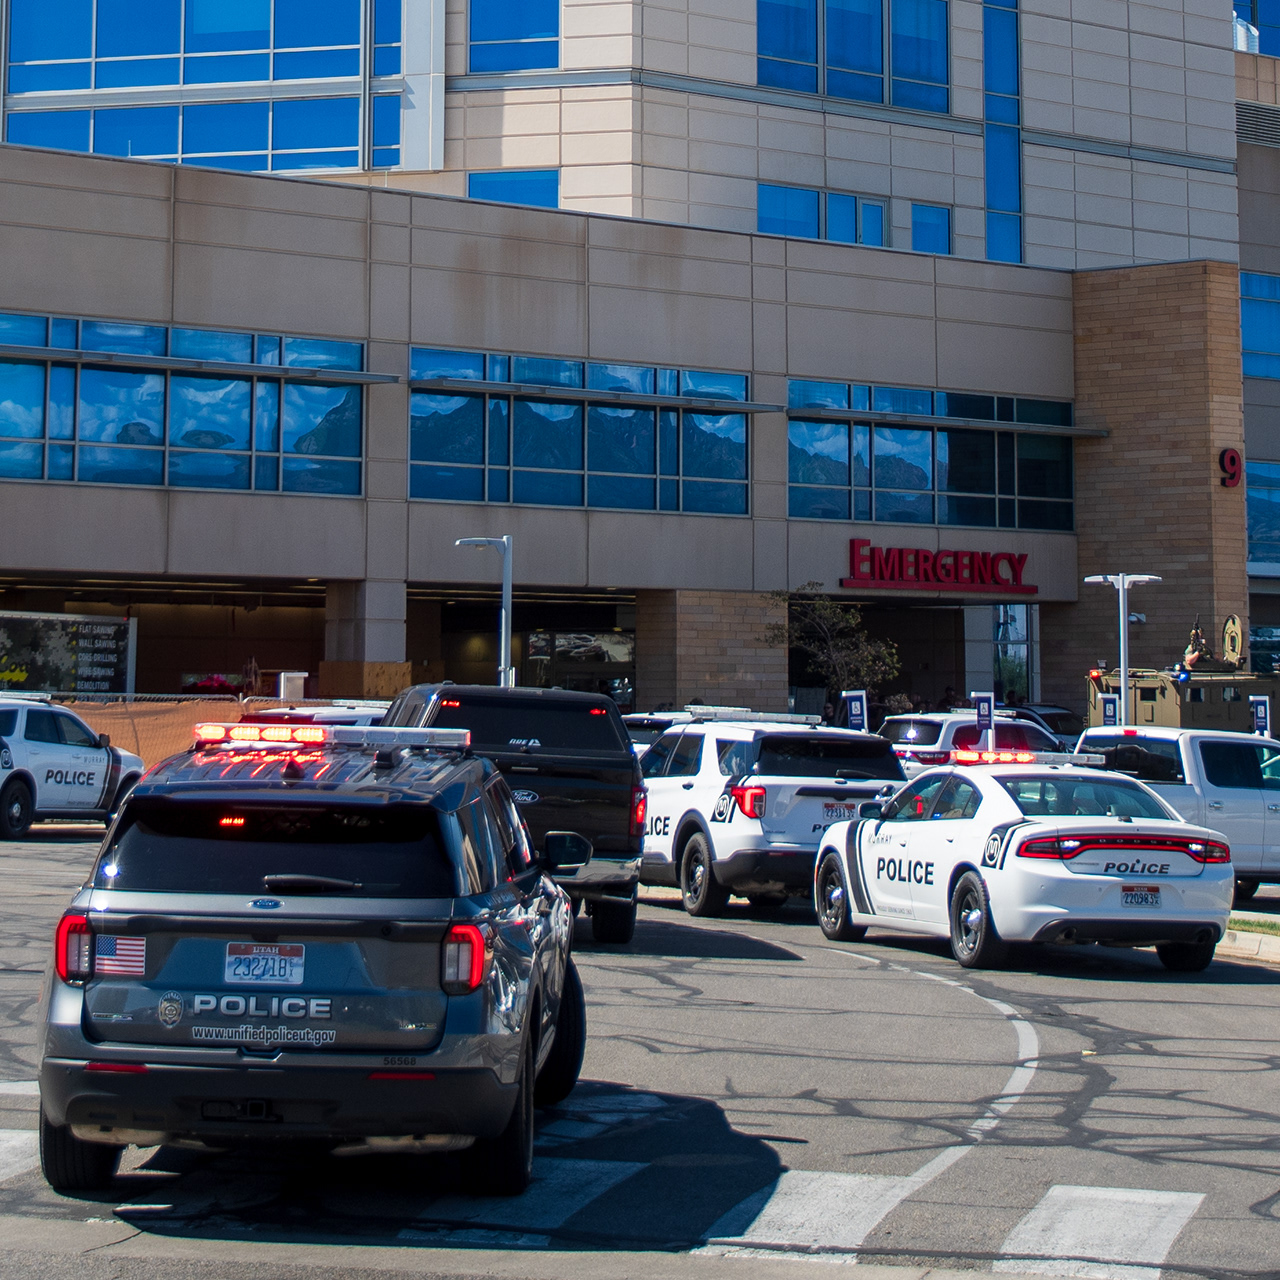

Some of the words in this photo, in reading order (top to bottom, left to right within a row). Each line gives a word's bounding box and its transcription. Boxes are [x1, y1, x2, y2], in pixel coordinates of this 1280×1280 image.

[1219, 448, 1242, 487] 9
[849, 538, 1028, 586] EMERGENCY
[78, 639, 93, 648] WALL
[94, 639, 117, 649] SAWING
[76, 681, 110, 690] DEMOLITION
[83, 756, 106, 764] MURRAY
[45, 769, 96, 786] POLICE
[514, 792, 534, 801] Ford
[877, 857, 934, 885] POLICE
[1103, 862, 1171, 874] POLICE
[1124, 892, 1154, 904] 220983
[233, 957, 287, 977] 232718
[193, 994, 332, 1019] POLICE
[192, 1024, 337, 1046] www.unifiedpoliceut.gov
[383, 1056, 417, 1066] 56568
